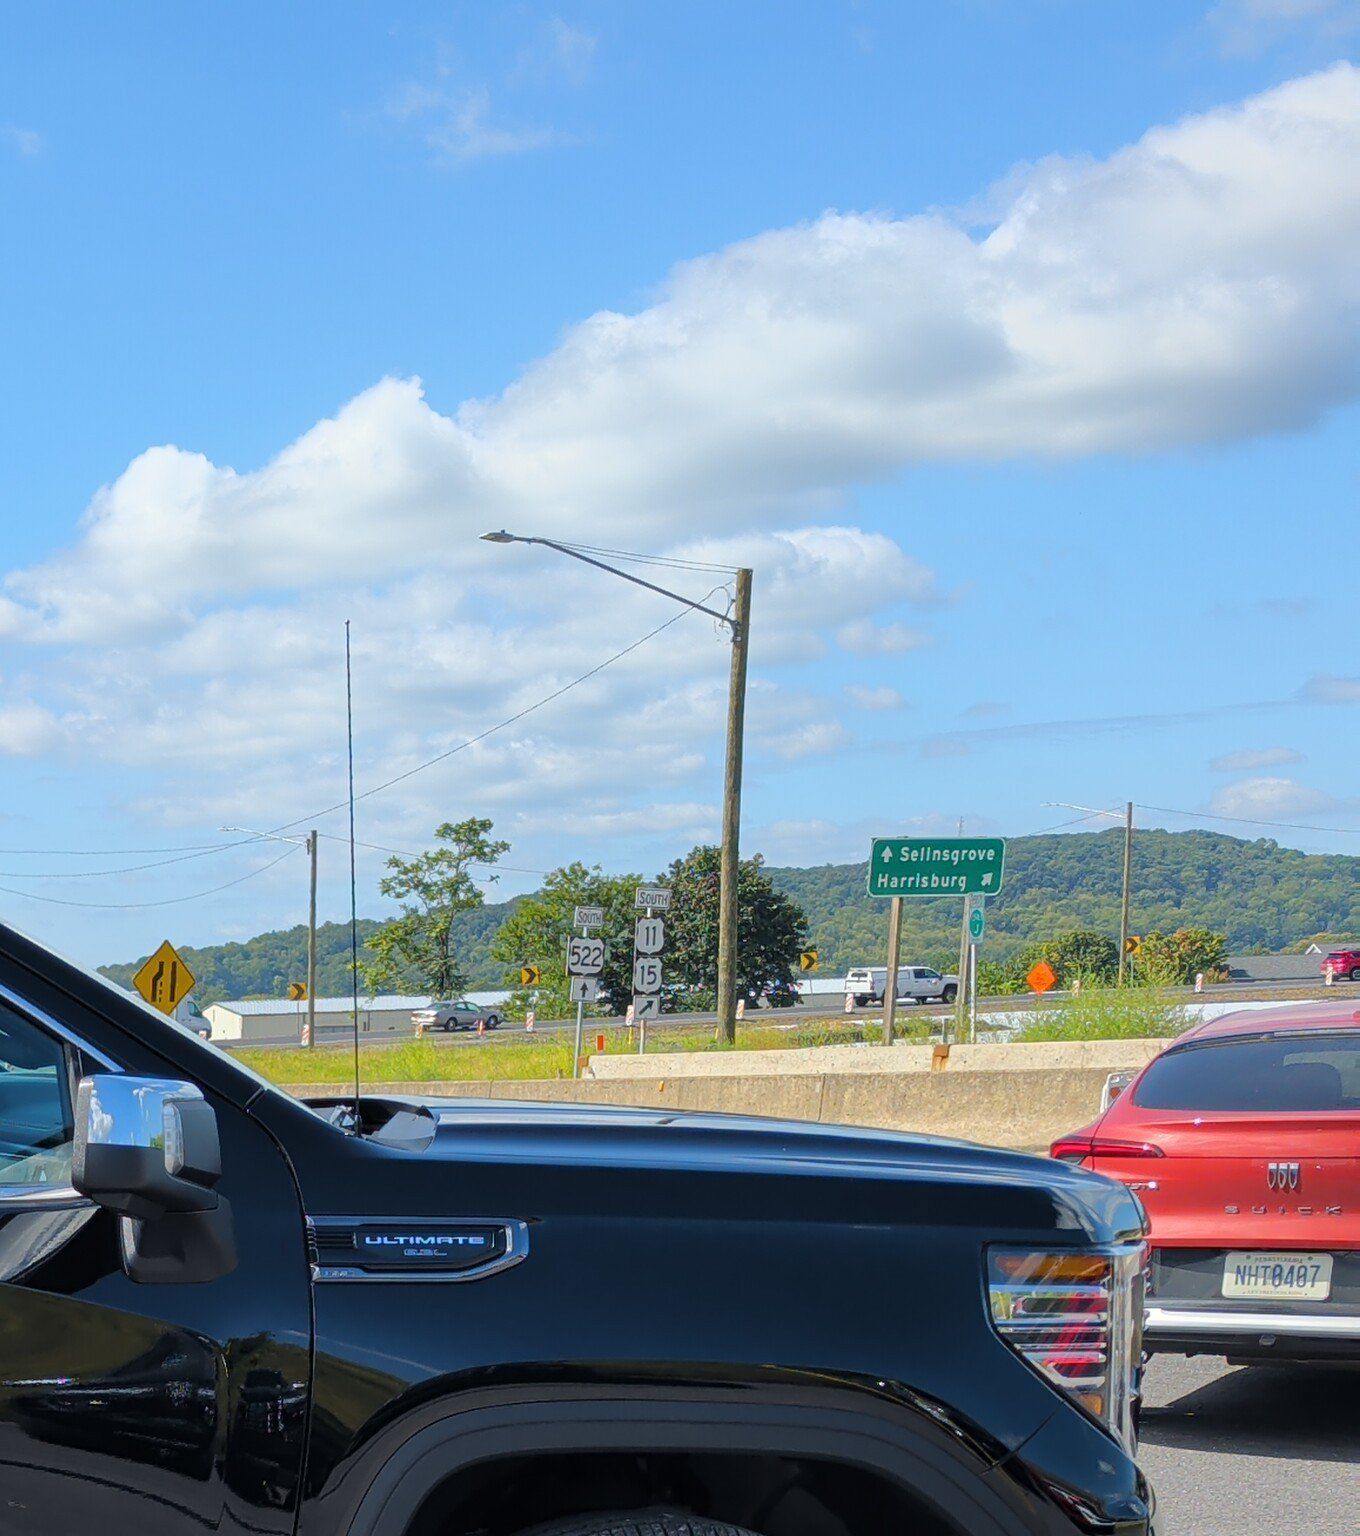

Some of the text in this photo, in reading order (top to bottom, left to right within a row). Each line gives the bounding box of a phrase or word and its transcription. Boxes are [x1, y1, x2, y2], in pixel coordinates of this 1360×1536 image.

[899, 847, 995, 866] Selinsgrove
[877, 873, 967, 892] Harrisburg
[639, 892, 669, 905] SOUTH
[577, 910, 601, 924] SOUTH
[644, 926, 657, 946] 11
[570, 945, 602, 967] 522
[640, 965, 657, 985] 15
[1225, 1205, 1342, 1214] BUICK
[365, 1236, 485, 1245] ULTIMATE
[1234, 1264, 1321, 1288] NHT0407
